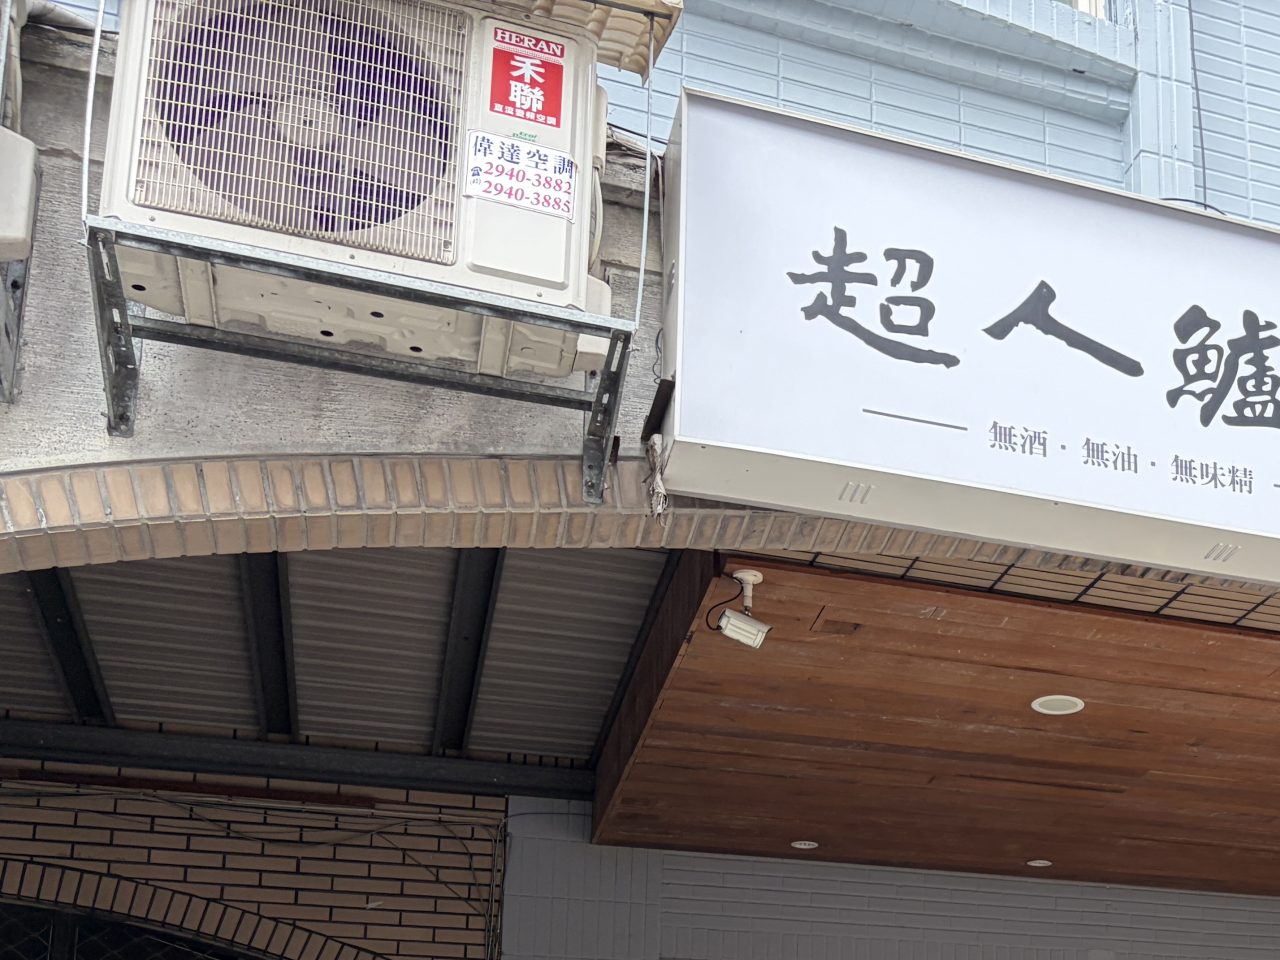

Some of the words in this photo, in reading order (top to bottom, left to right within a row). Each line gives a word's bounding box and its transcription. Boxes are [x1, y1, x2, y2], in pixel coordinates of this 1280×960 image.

[495, 28, 563, 57] HERAN
[508, 54, 546, 112] 禾聯
[473, 135, 574, 180] 偉達空調
[483, 161, 572, 196] 2940-3882
[482, 180, 571, 214] 2940-3885
